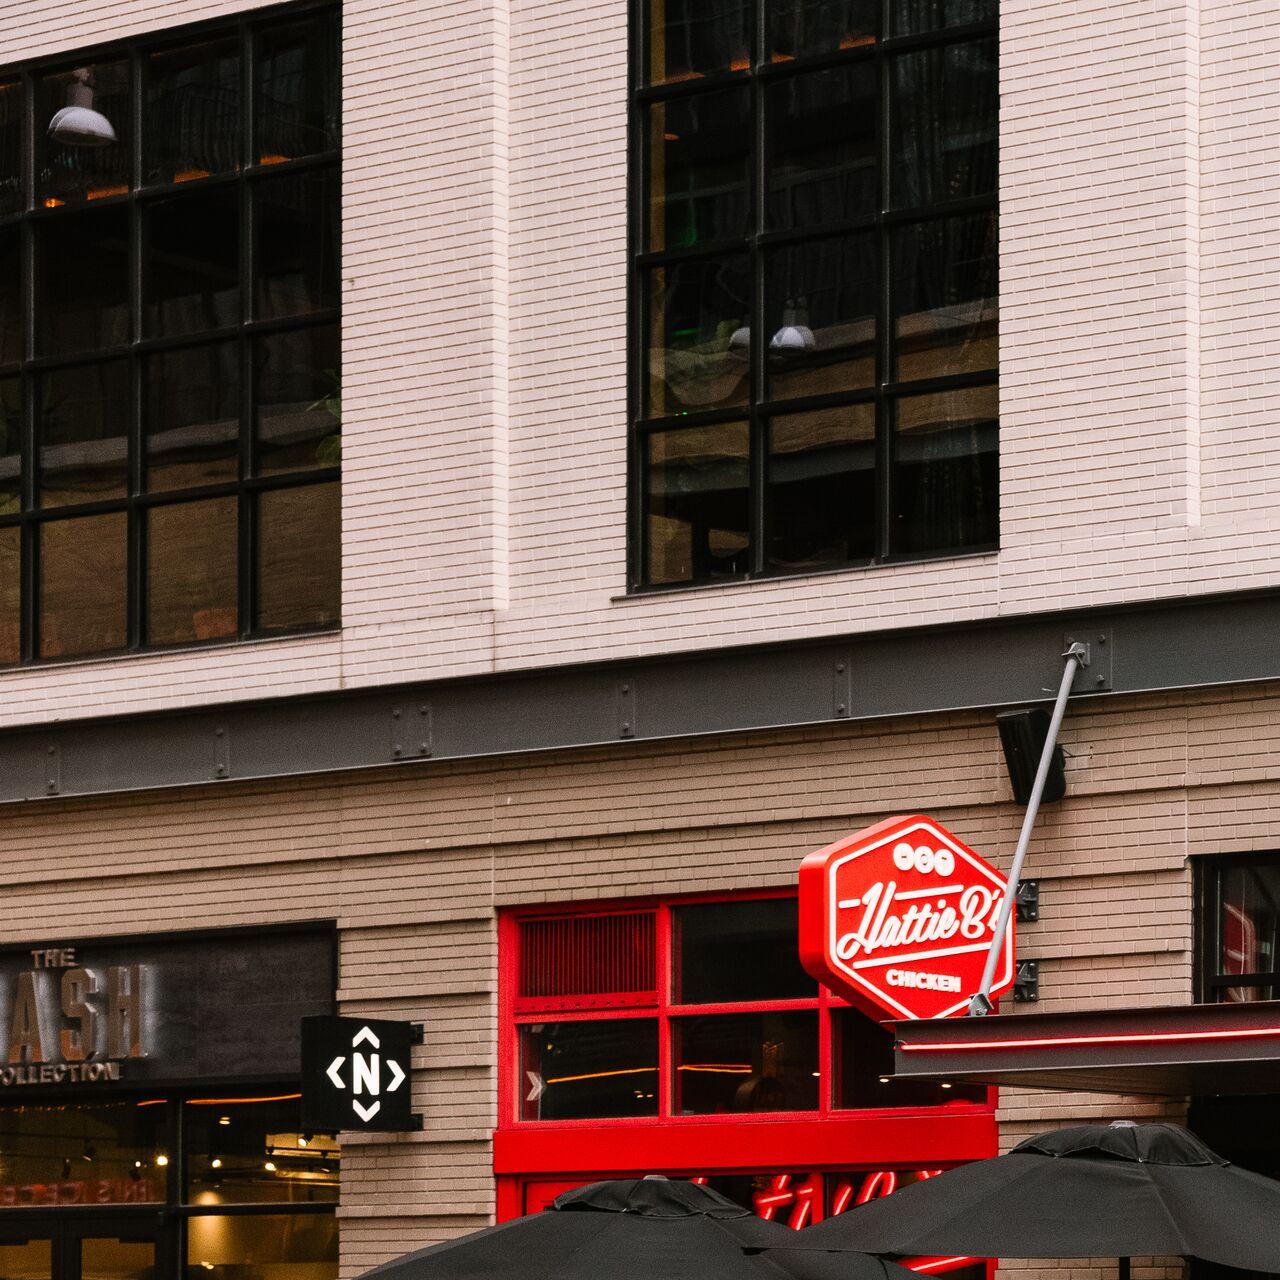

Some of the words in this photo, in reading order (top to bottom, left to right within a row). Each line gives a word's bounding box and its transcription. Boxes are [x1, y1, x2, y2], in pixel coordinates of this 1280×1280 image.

[836, 880, 960, 960] Hattie
[31, 948, 79, 968] THE
[886, 969, 961, 992] CHICKEN
[0, 1062, 124, 1086] OLLECTION
[352, 1052, 380, 1096] N
